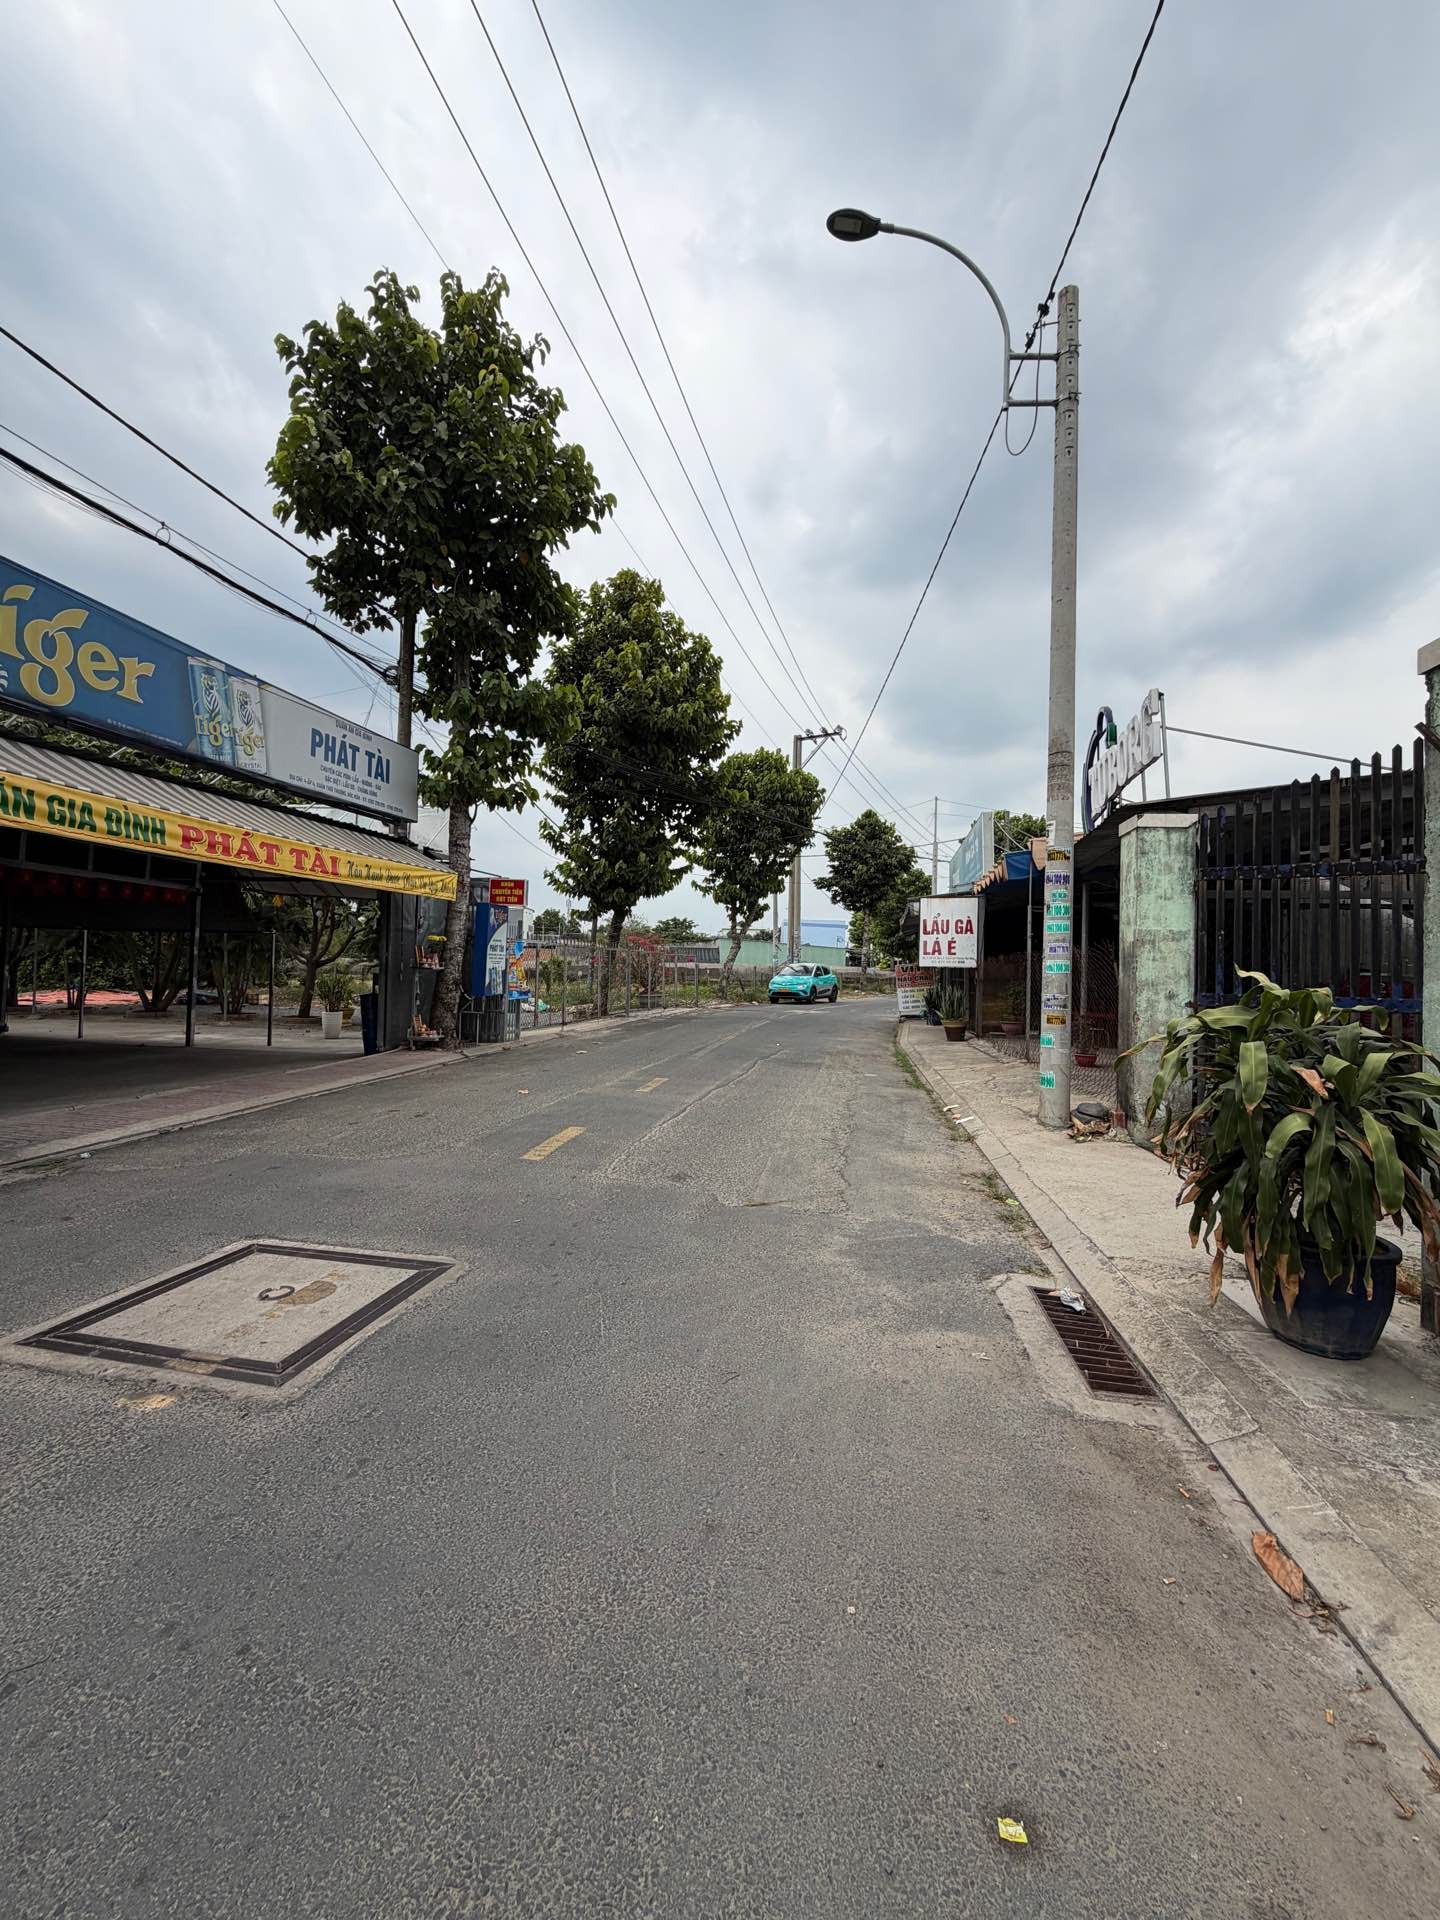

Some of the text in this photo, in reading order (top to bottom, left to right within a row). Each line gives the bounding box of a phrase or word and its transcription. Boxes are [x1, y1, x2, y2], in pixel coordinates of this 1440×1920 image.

[310, 727, 390, 784] PHÁT TÀI
[46, 794, 97, 833] GIA
[104, 802, 167, 845] ĐÌNH
[177, 823, 282, 867] PHÁT
[289, 847, 341, 877] TÀI
[923, 913, 974, 935] LẨU GÀ
[923, 937, 957, 956] LÁ É
